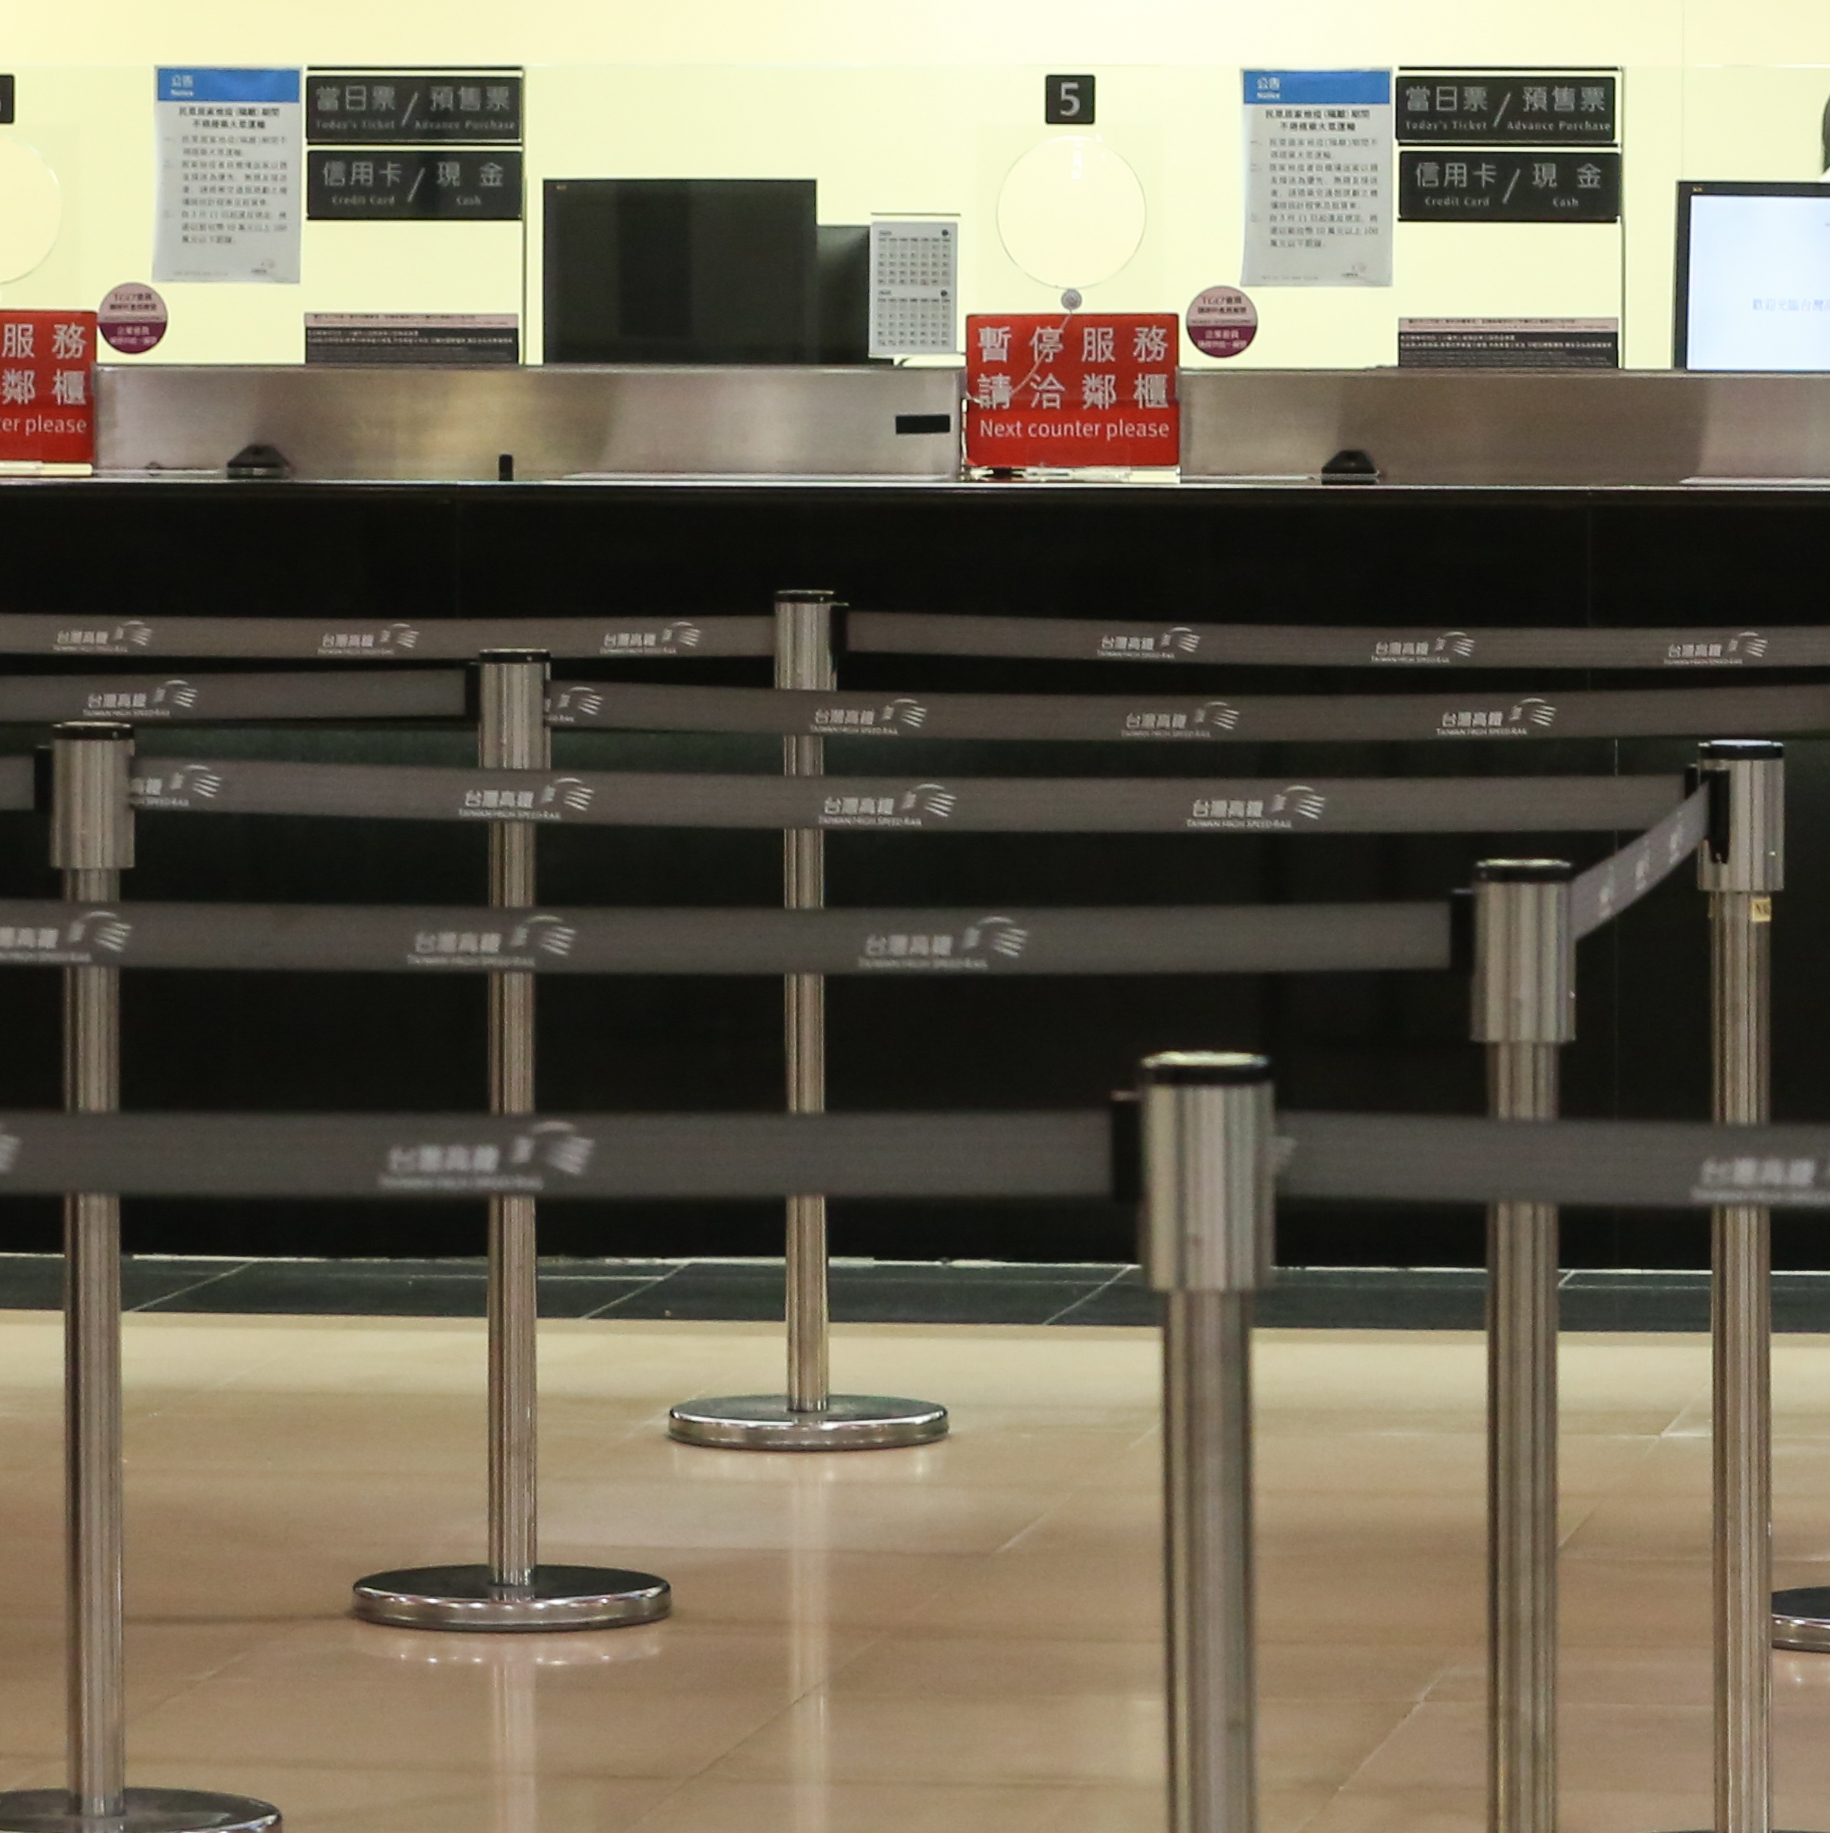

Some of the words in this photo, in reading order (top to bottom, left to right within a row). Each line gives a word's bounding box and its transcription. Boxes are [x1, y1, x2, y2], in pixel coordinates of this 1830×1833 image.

[1061, 82, 1080, 116] 5
[1416, 162, 1496, 188] 信用卡
[1532, 163, 1601, 188] 現金
[978, 324, 1168, 365] 暫停服務
[981, 420, 1022, 437] Next
[1028, 421, 1100, 437] counter
[1107, 419, 1169, 441] please
